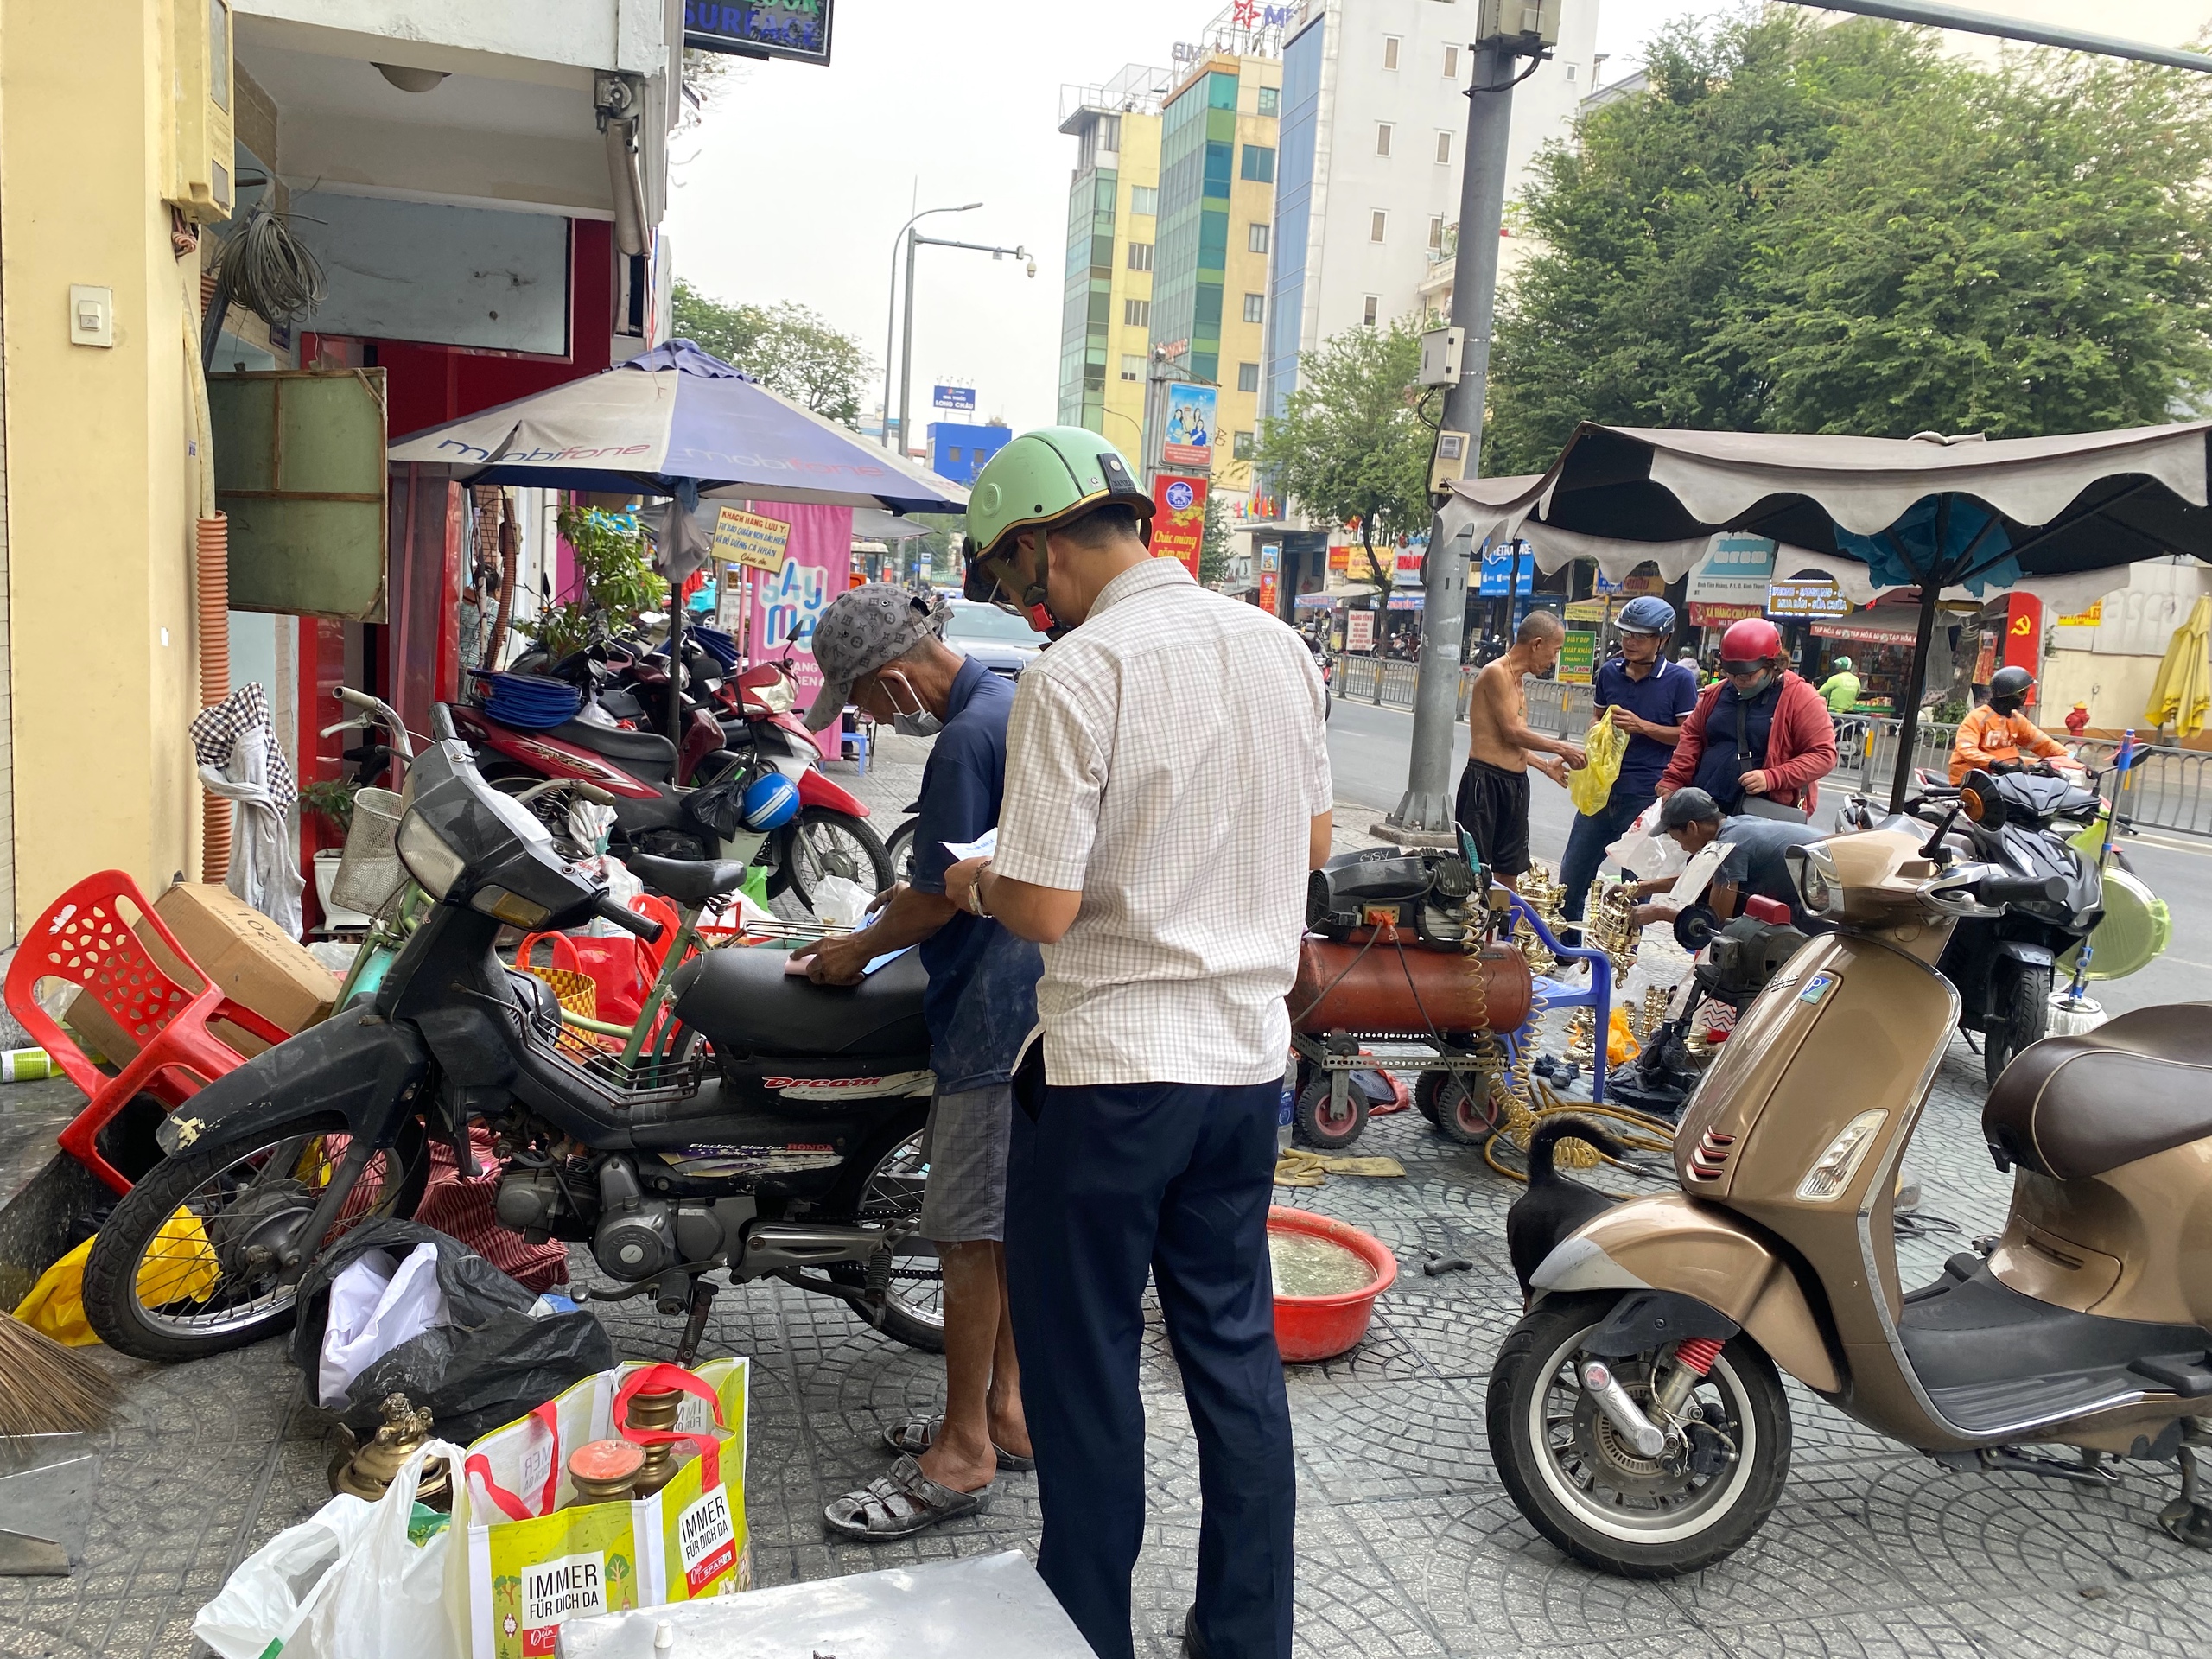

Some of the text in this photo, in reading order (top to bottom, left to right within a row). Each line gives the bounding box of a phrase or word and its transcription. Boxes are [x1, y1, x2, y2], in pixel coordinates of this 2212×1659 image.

[683, 446, 884, 477] mobifone
[1154, 529, 1174, 544] Chúc
[762, 1076, 884, 1089] Dream
[786, 1142, 834, 1151] HONDA
[681, 1495, 726, 1544] IMMER
[685, 1519, 729, 1561] FÜR DICH DA
[702, 1556, 724, 1577] SPAR
[529, 1563, 598, 1600] IMMER
[530, 1591, 599, 1619] FÜR DICH DA
[531, 1627, 555, 1647] Dein
